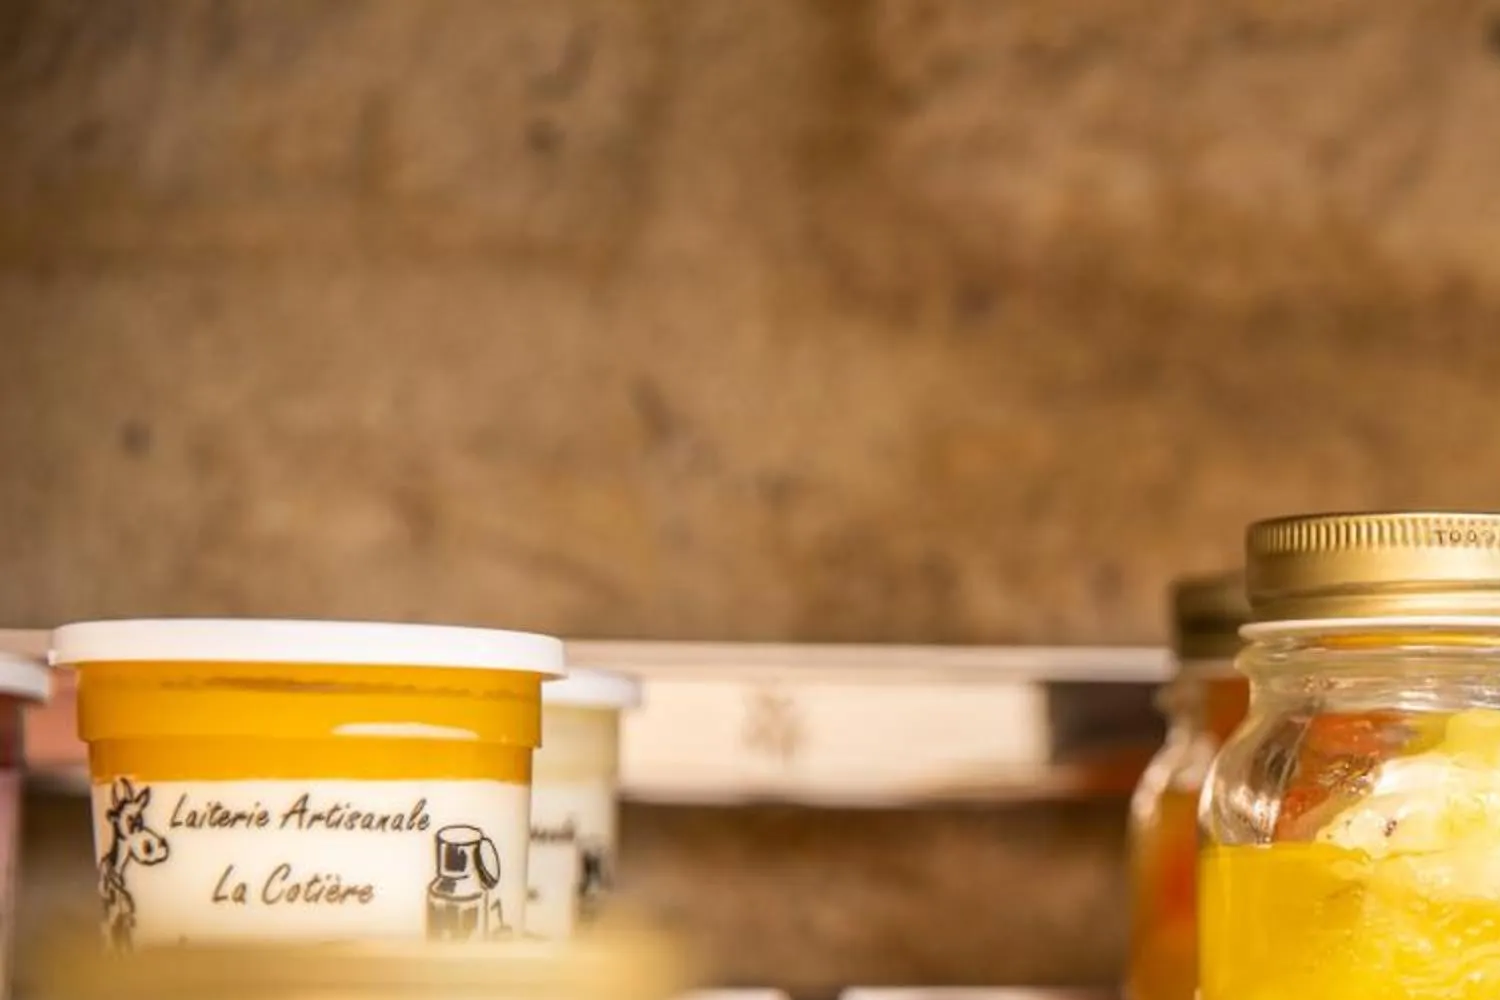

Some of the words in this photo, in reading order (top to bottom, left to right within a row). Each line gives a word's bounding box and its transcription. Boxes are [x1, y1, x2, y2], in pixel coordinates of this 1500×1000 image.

[169, 793, 271, 829] Laiterie
[279, 793, 431, 832] Artisanale
[211, 864, 248, 905] La
